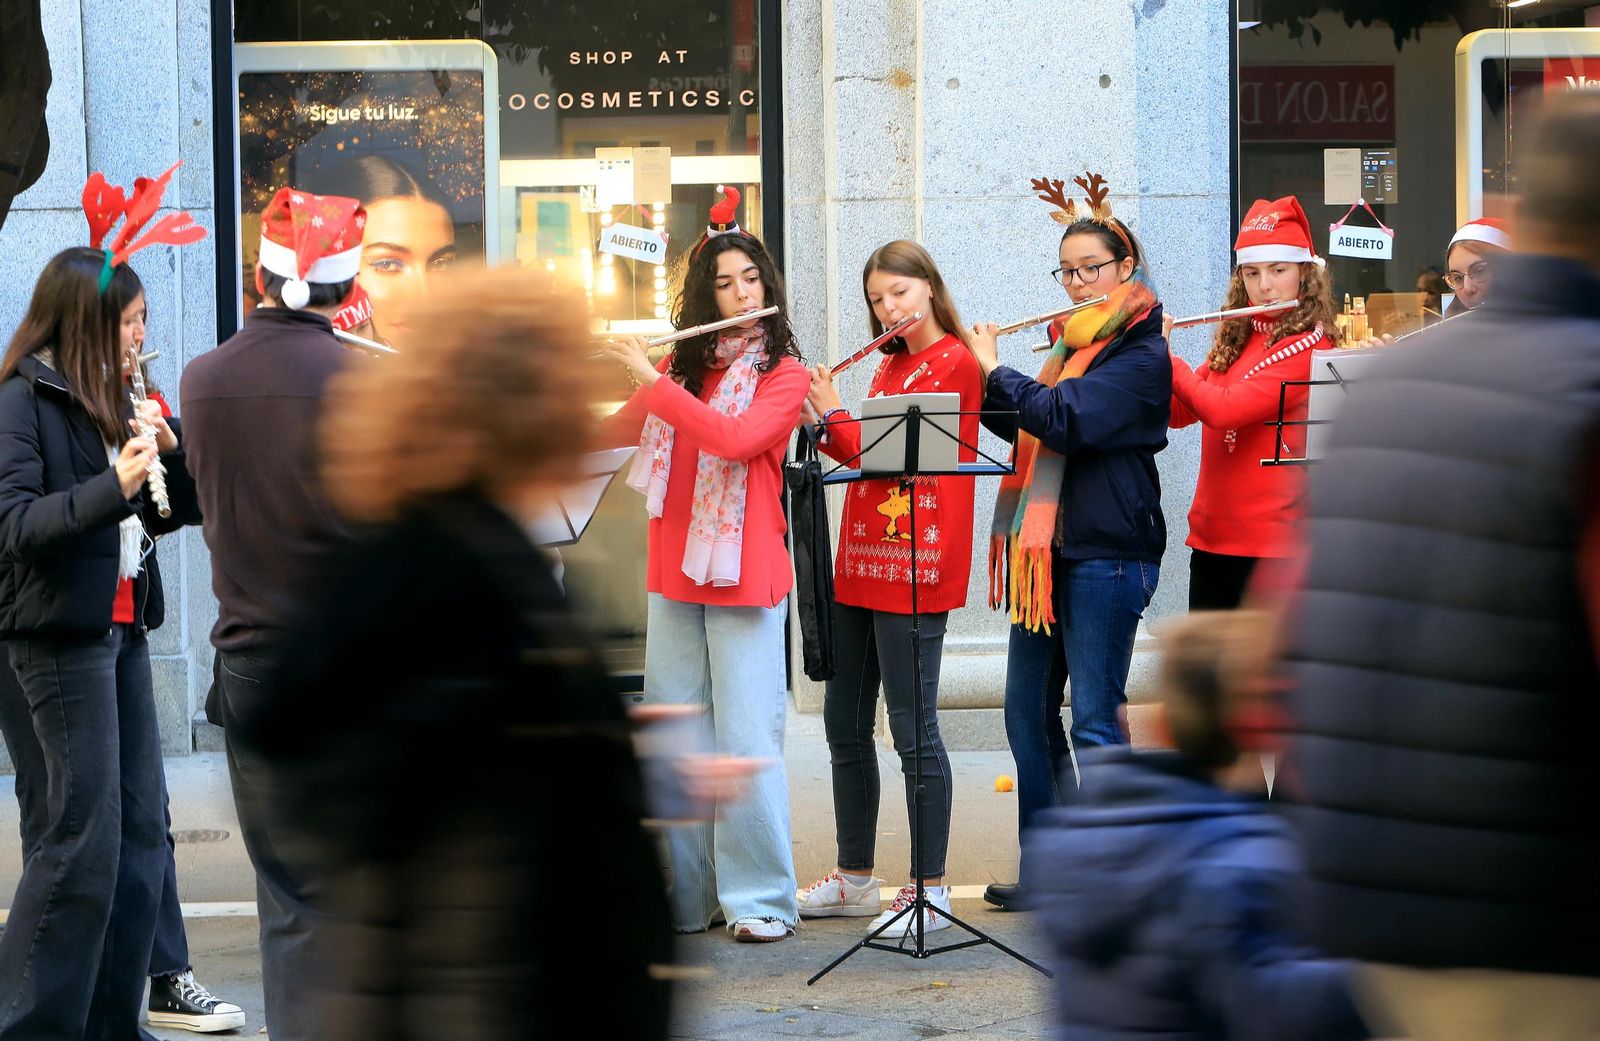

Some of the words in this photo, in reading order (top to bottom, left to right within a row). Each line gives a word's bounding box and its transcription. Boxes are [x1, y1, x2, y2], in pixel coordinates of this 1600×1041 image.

[569, 50, 633, 65] SHOP
[658, 50, 688, 64] AT
[498, 90, 755, 111] OCOSMETICS.C
[309, 104, 361, 125] Sigue
[364, 105, 385, 120] tu
[388, 103, 419, 120] luz.
[610, 233, 658, 254] ABIERTO
[1337, 236, 1384, 250] ABIERTO
